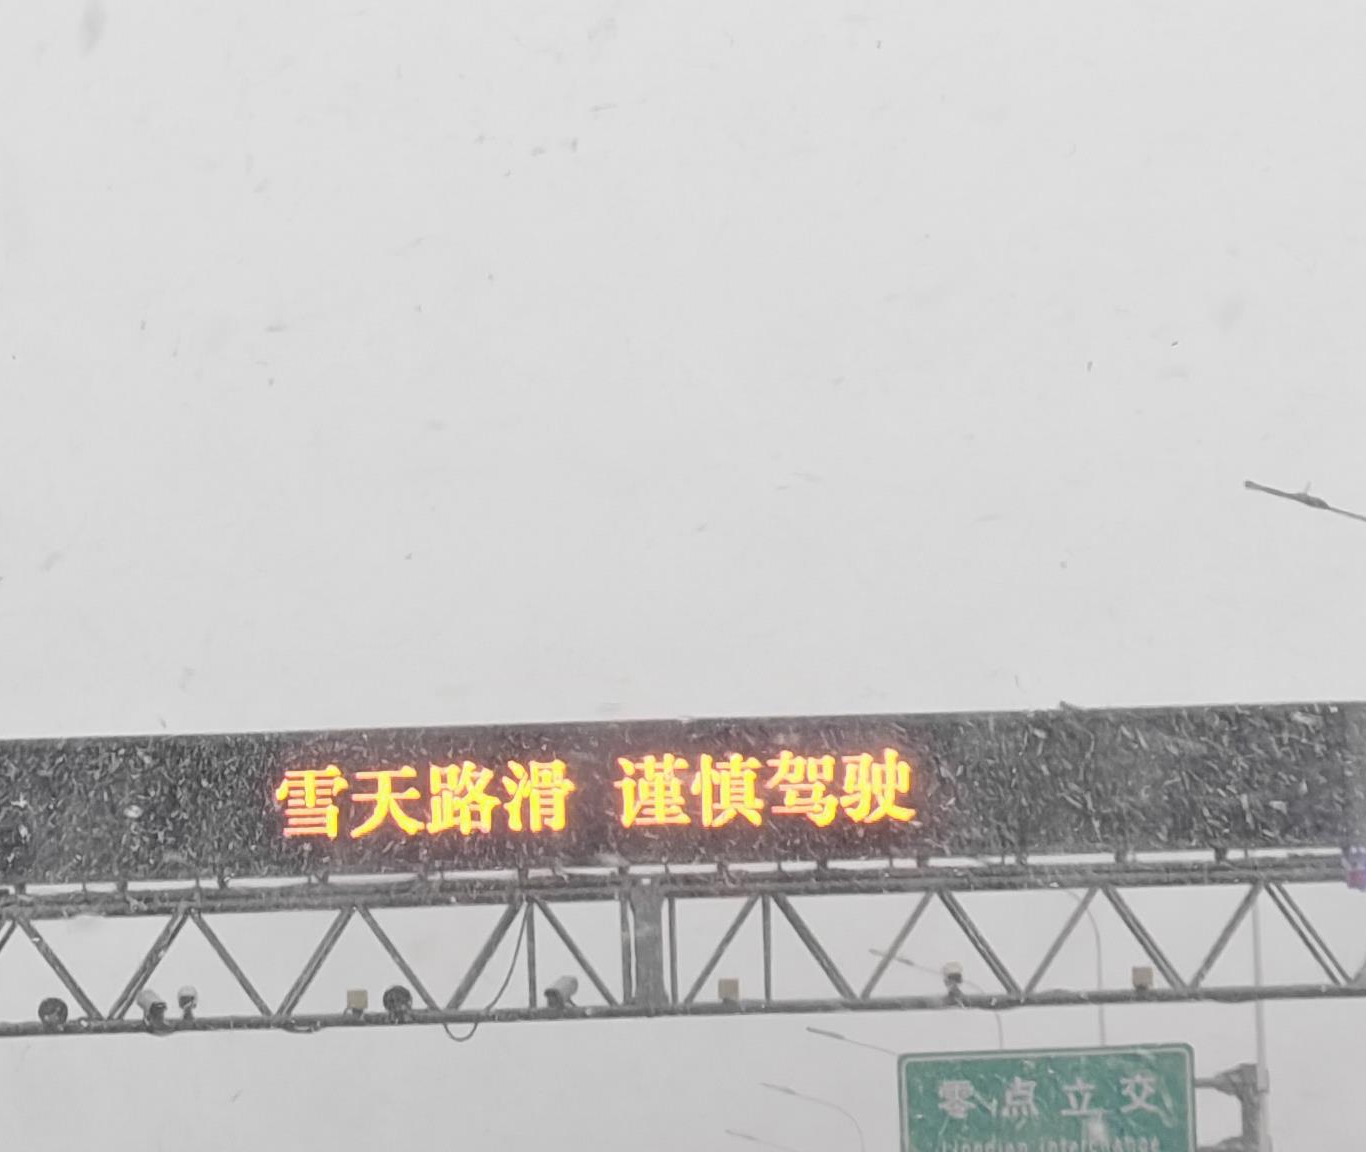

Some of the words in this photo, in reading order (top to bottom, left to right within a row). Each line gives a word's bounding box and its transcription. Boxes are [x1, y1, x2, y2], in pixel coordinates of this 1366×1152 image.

[275, 759, 574, 838] 雪天路滑
[615, 748, 916, 828] 谨慎驾驶
[938, 1073, 1164, 1119] 零点立交
